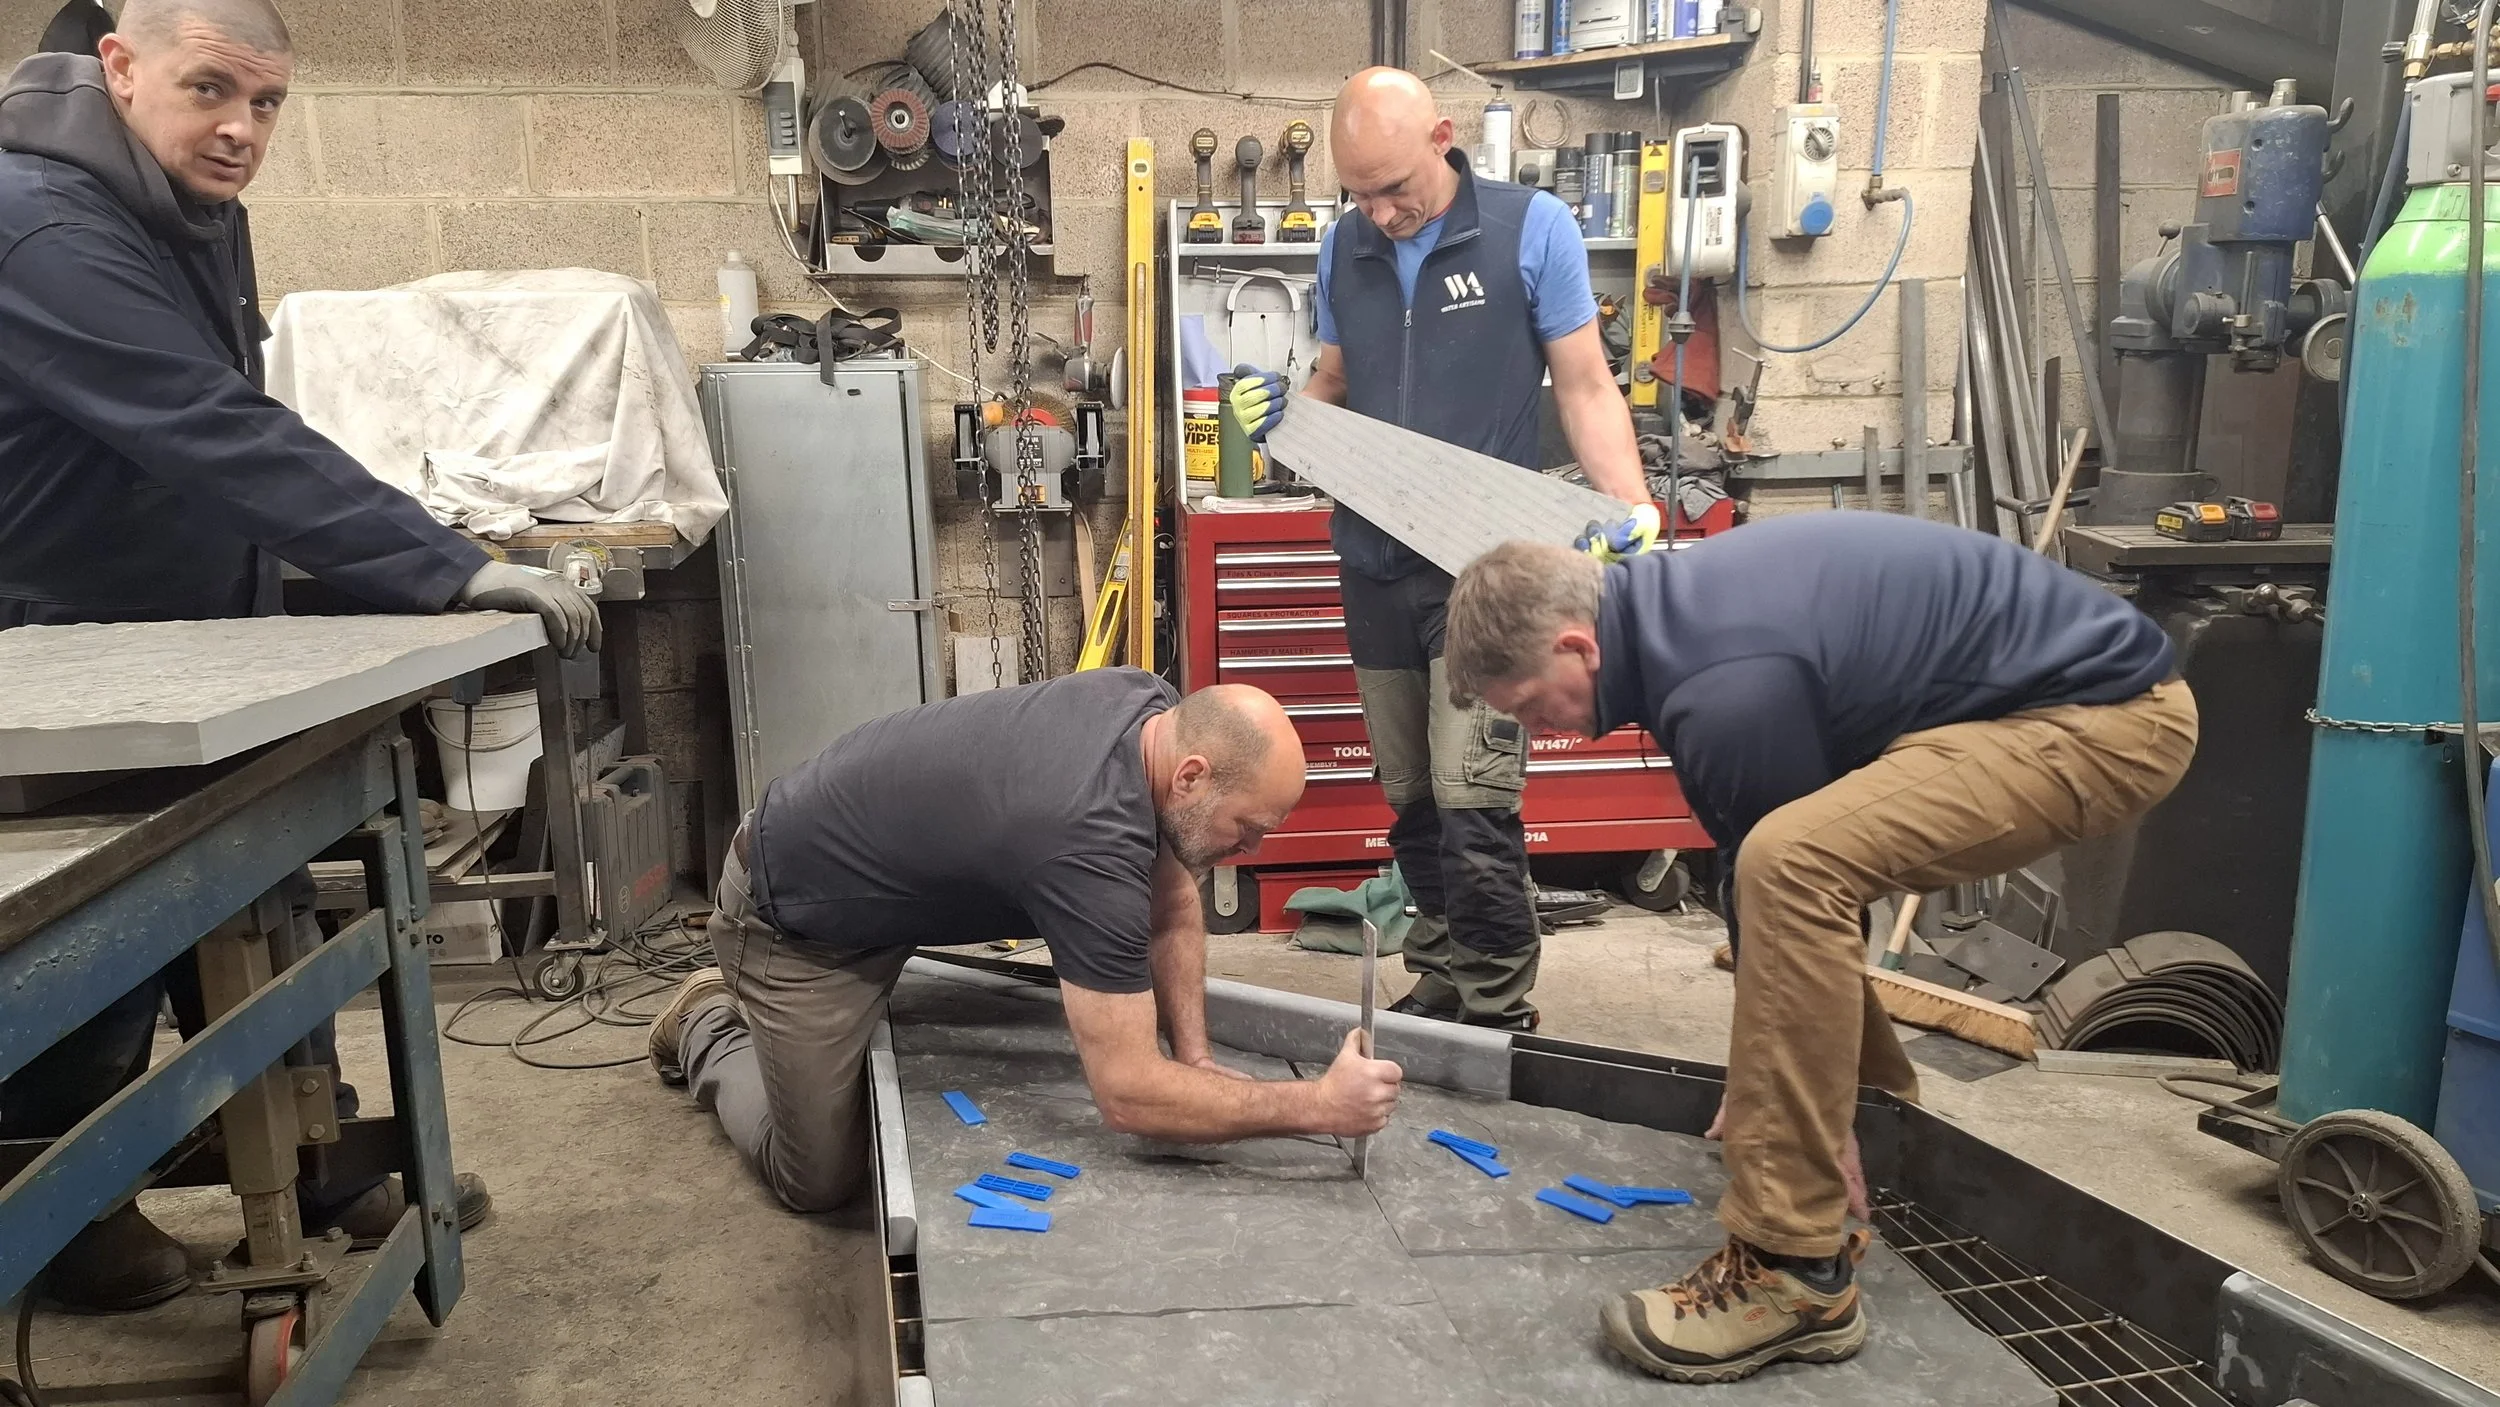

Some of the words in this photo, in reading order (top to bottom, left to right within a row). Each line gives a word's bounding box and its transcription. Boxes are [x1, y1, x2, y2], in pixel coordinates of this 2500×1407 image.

[1184, 422, 1219, 433] ONDE
[1532, 738, 1583, 750] W147/
[1366, 838, 1390, 848] ME
